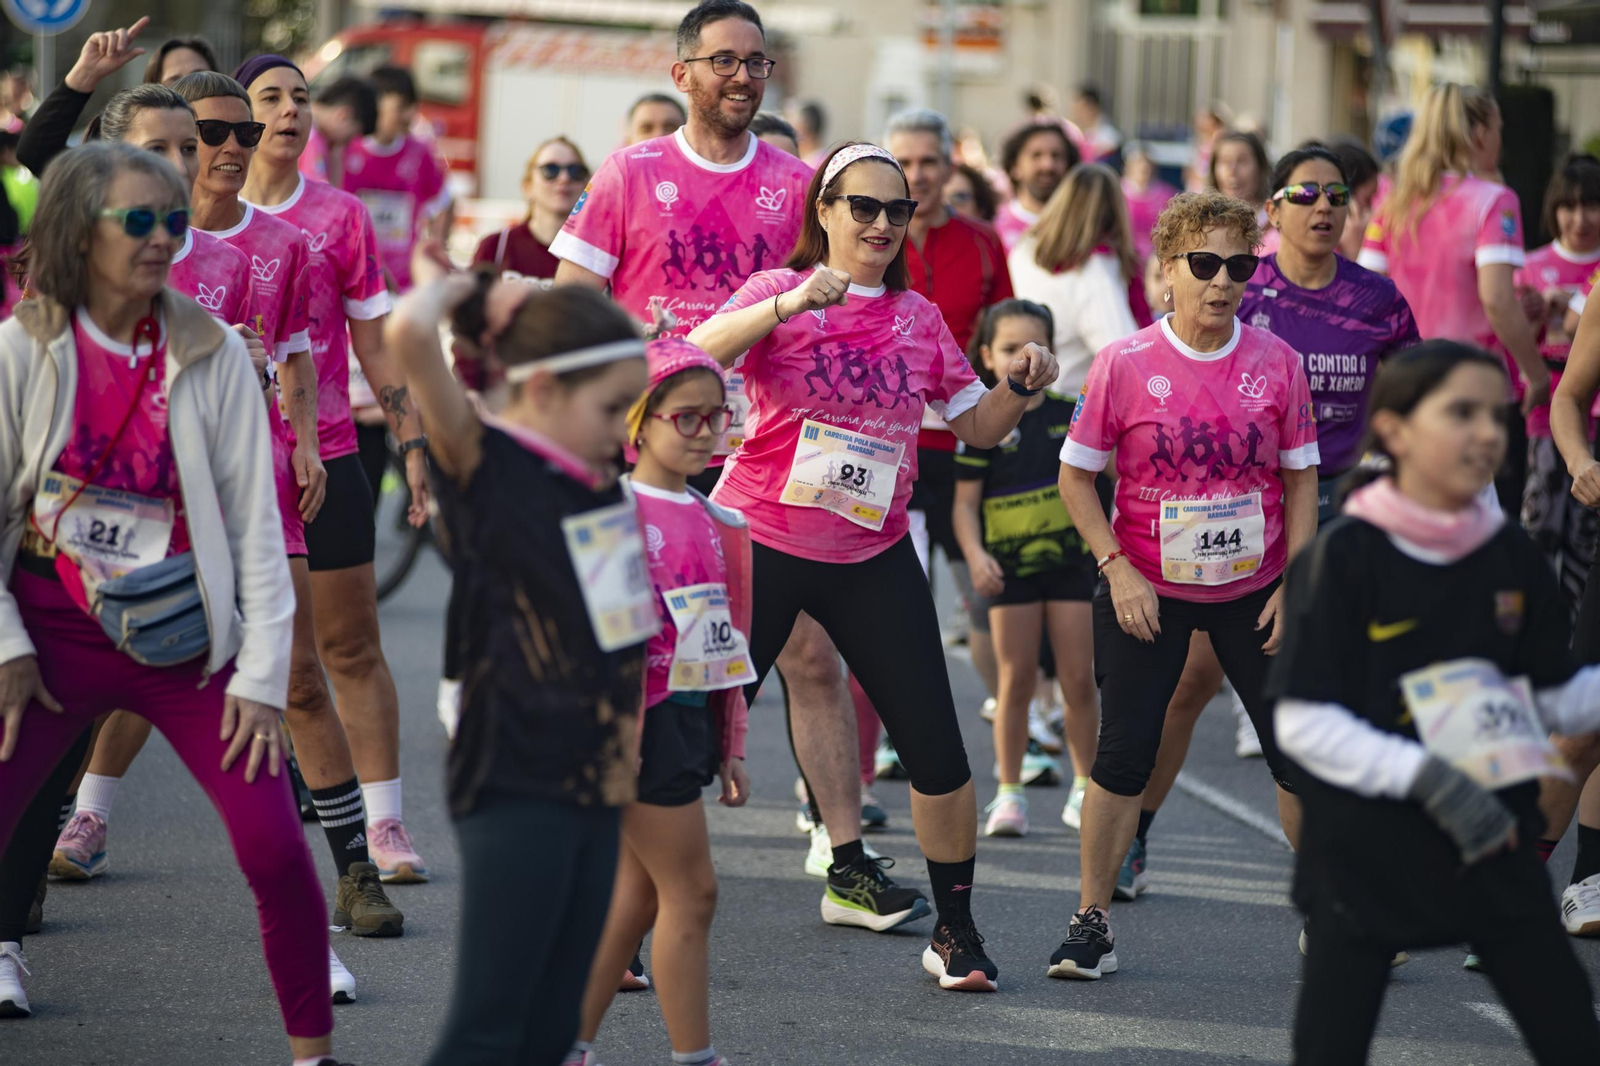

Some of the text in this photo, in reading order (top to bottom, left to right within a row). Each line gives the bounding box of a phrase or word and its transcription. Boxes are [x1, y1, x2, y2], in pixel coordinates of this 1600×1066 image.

[667, 297, 716, 311] Carreira
[1308, 353, 1358, 374] CONTRA
[1360, 355, 1367, 373] A
[1310, 374, 1325, 391] DE
[810, 408, 860, 425] Carreira
[804, 425, 820, 441] III
[824, 430, 853, 443] CARREIRA
[853, 437, 868, 447] POLA
[841, 464, 867, 486] 93
[1138, 486, 1161, 502] III
[1160, 489, 1207, 501] Carreira
[1165, 506, 1178, 519] III
[1183, 505, 1212, 514] CARREIRA
[1212, 503, 1228, 512] POLA
[89, 520, 120, 546] 21
[1201, 528, 1241, 549] 144
